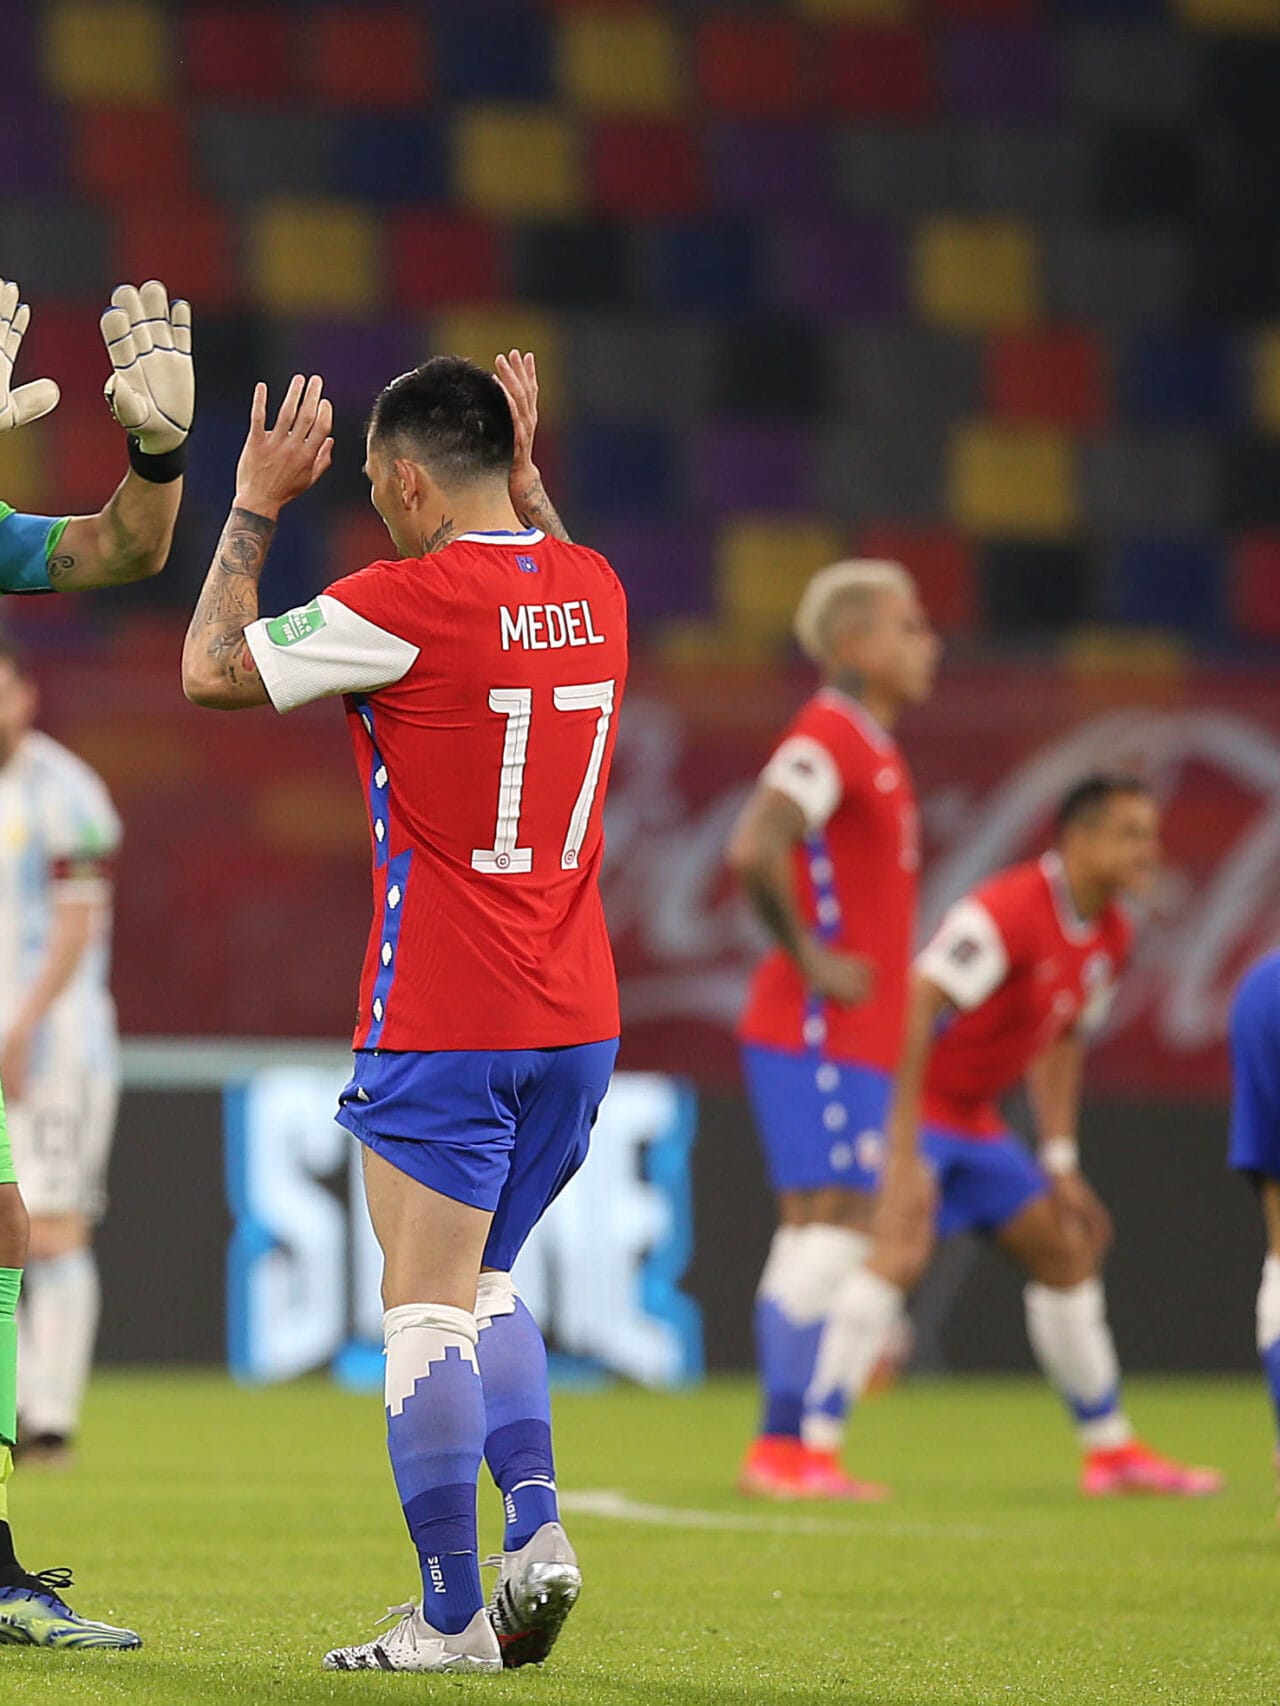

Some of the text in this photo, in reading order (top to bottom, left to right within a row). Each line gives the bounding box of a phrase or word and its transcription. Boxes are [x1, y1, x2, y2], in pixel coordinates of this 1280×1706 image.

[499, 599, 606, 651] MEDEL
[470, 679, 616, 875] 17
[427, 1555, 447, 1595] SIGN
